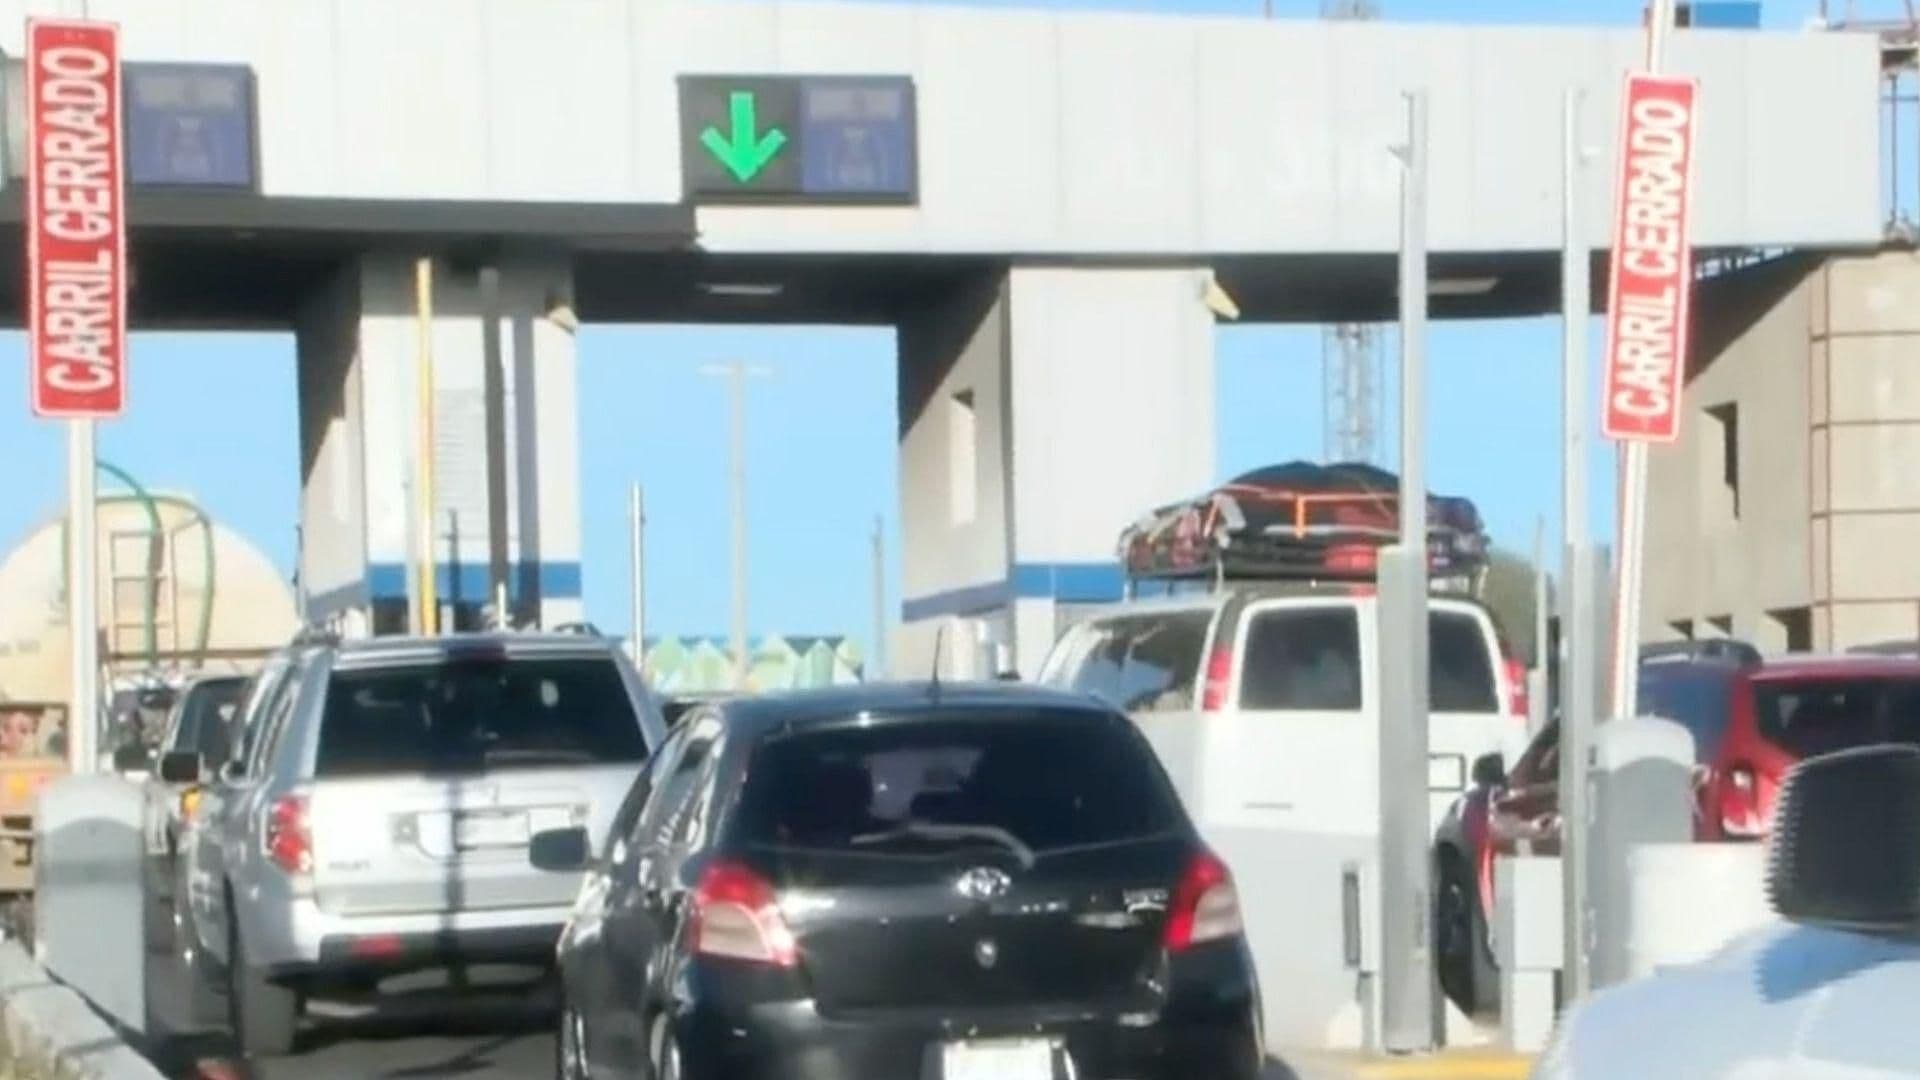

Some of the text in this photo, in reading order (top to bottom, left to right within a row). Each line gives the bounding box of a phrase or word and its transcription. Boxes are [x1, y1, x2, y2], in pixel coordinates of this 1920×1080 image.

[41, 47, 113, 392] CARRIL CERRADO
[1614, 99, 1688, 416] CARRIL CERRADO
